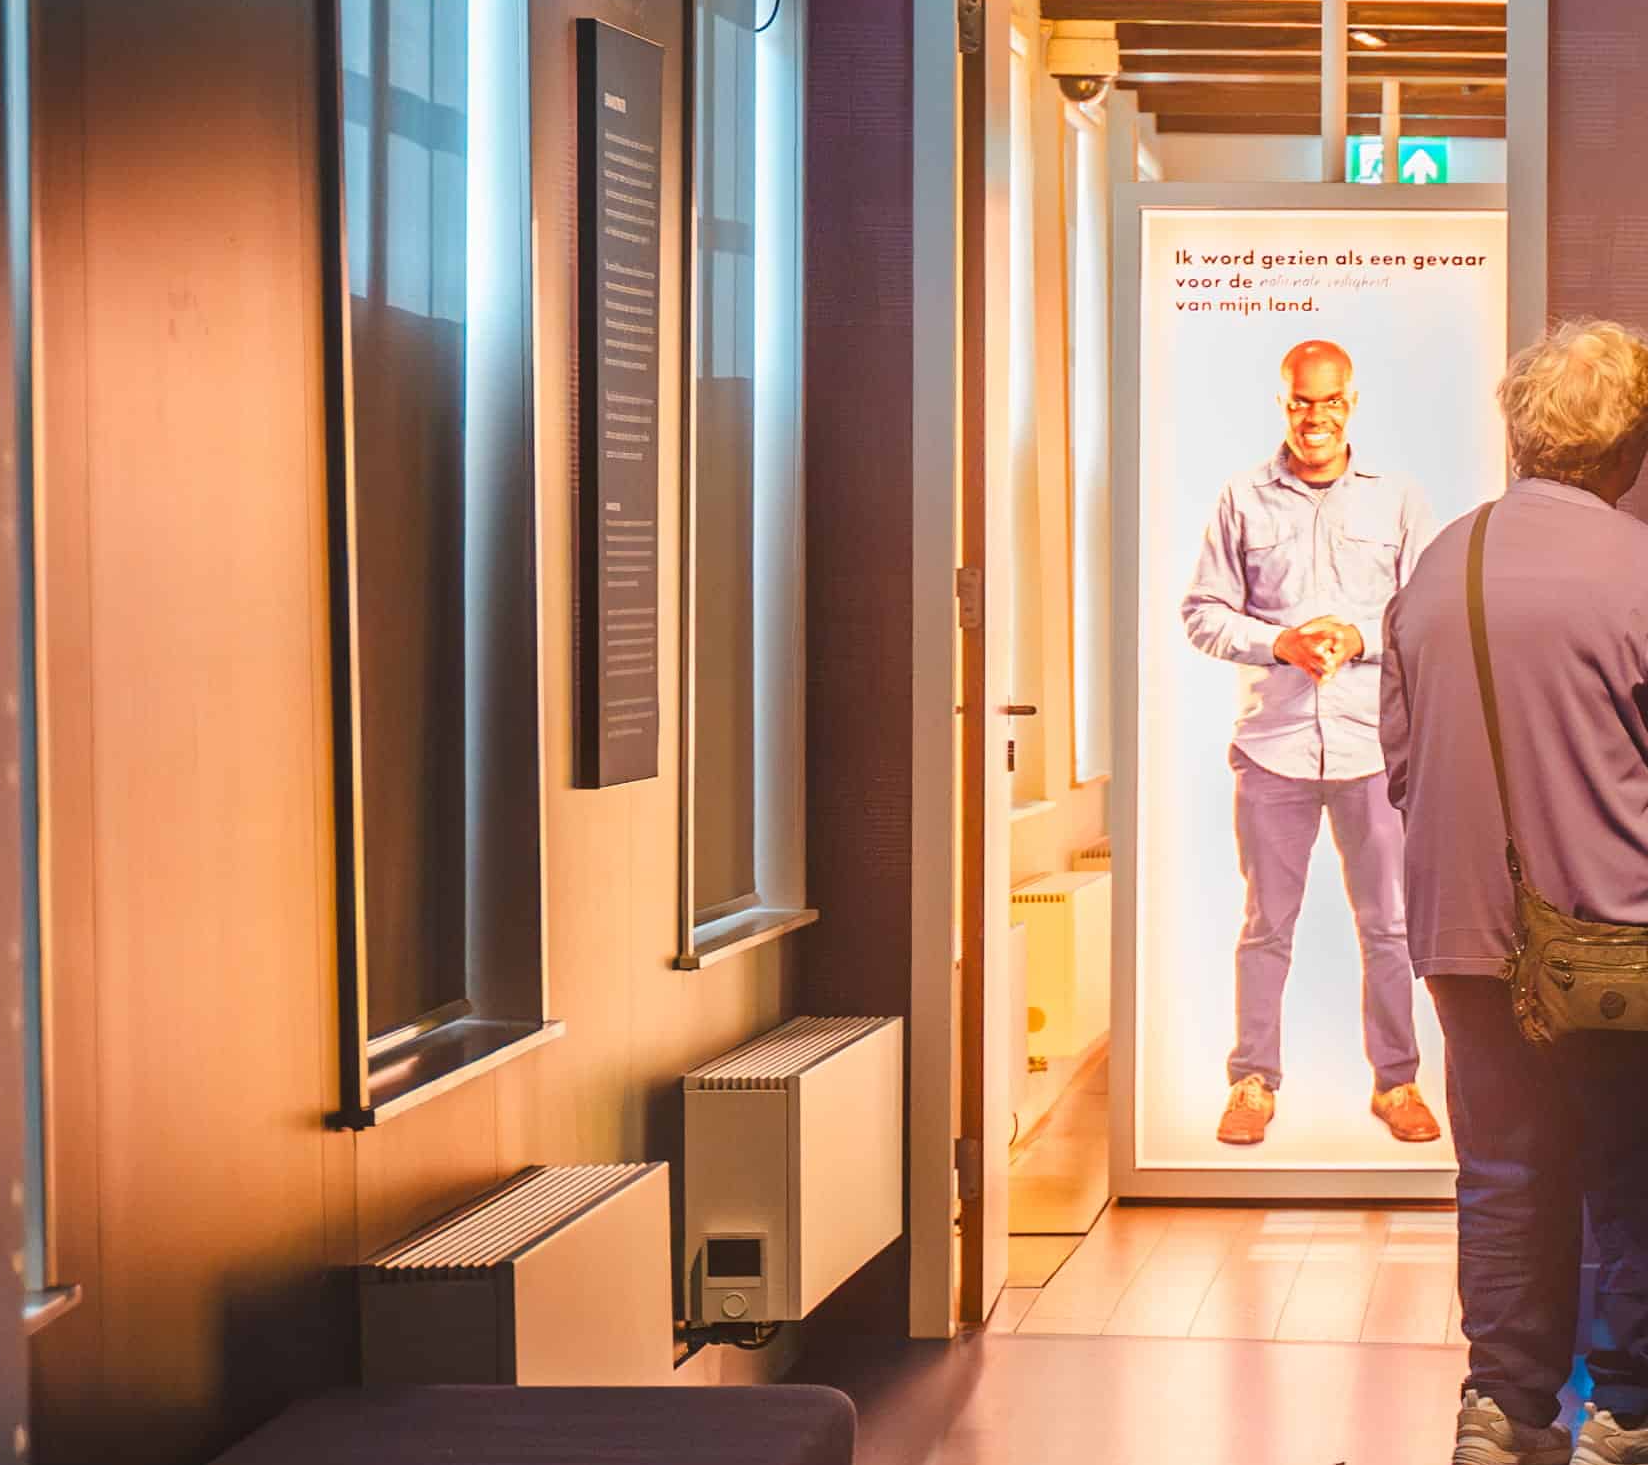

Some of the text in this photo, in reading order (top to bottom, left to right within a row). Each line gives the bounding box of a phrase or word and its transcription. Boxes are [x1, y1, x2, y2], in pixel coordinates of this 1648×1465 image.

[1176, 251, 1487, 270] Ik word gezien als een gevaar
[1176, 276, 1221, 288] voor
[1230, 274, 1253, 288] de
[1176, 297, 1320, 316] van mijn land.
